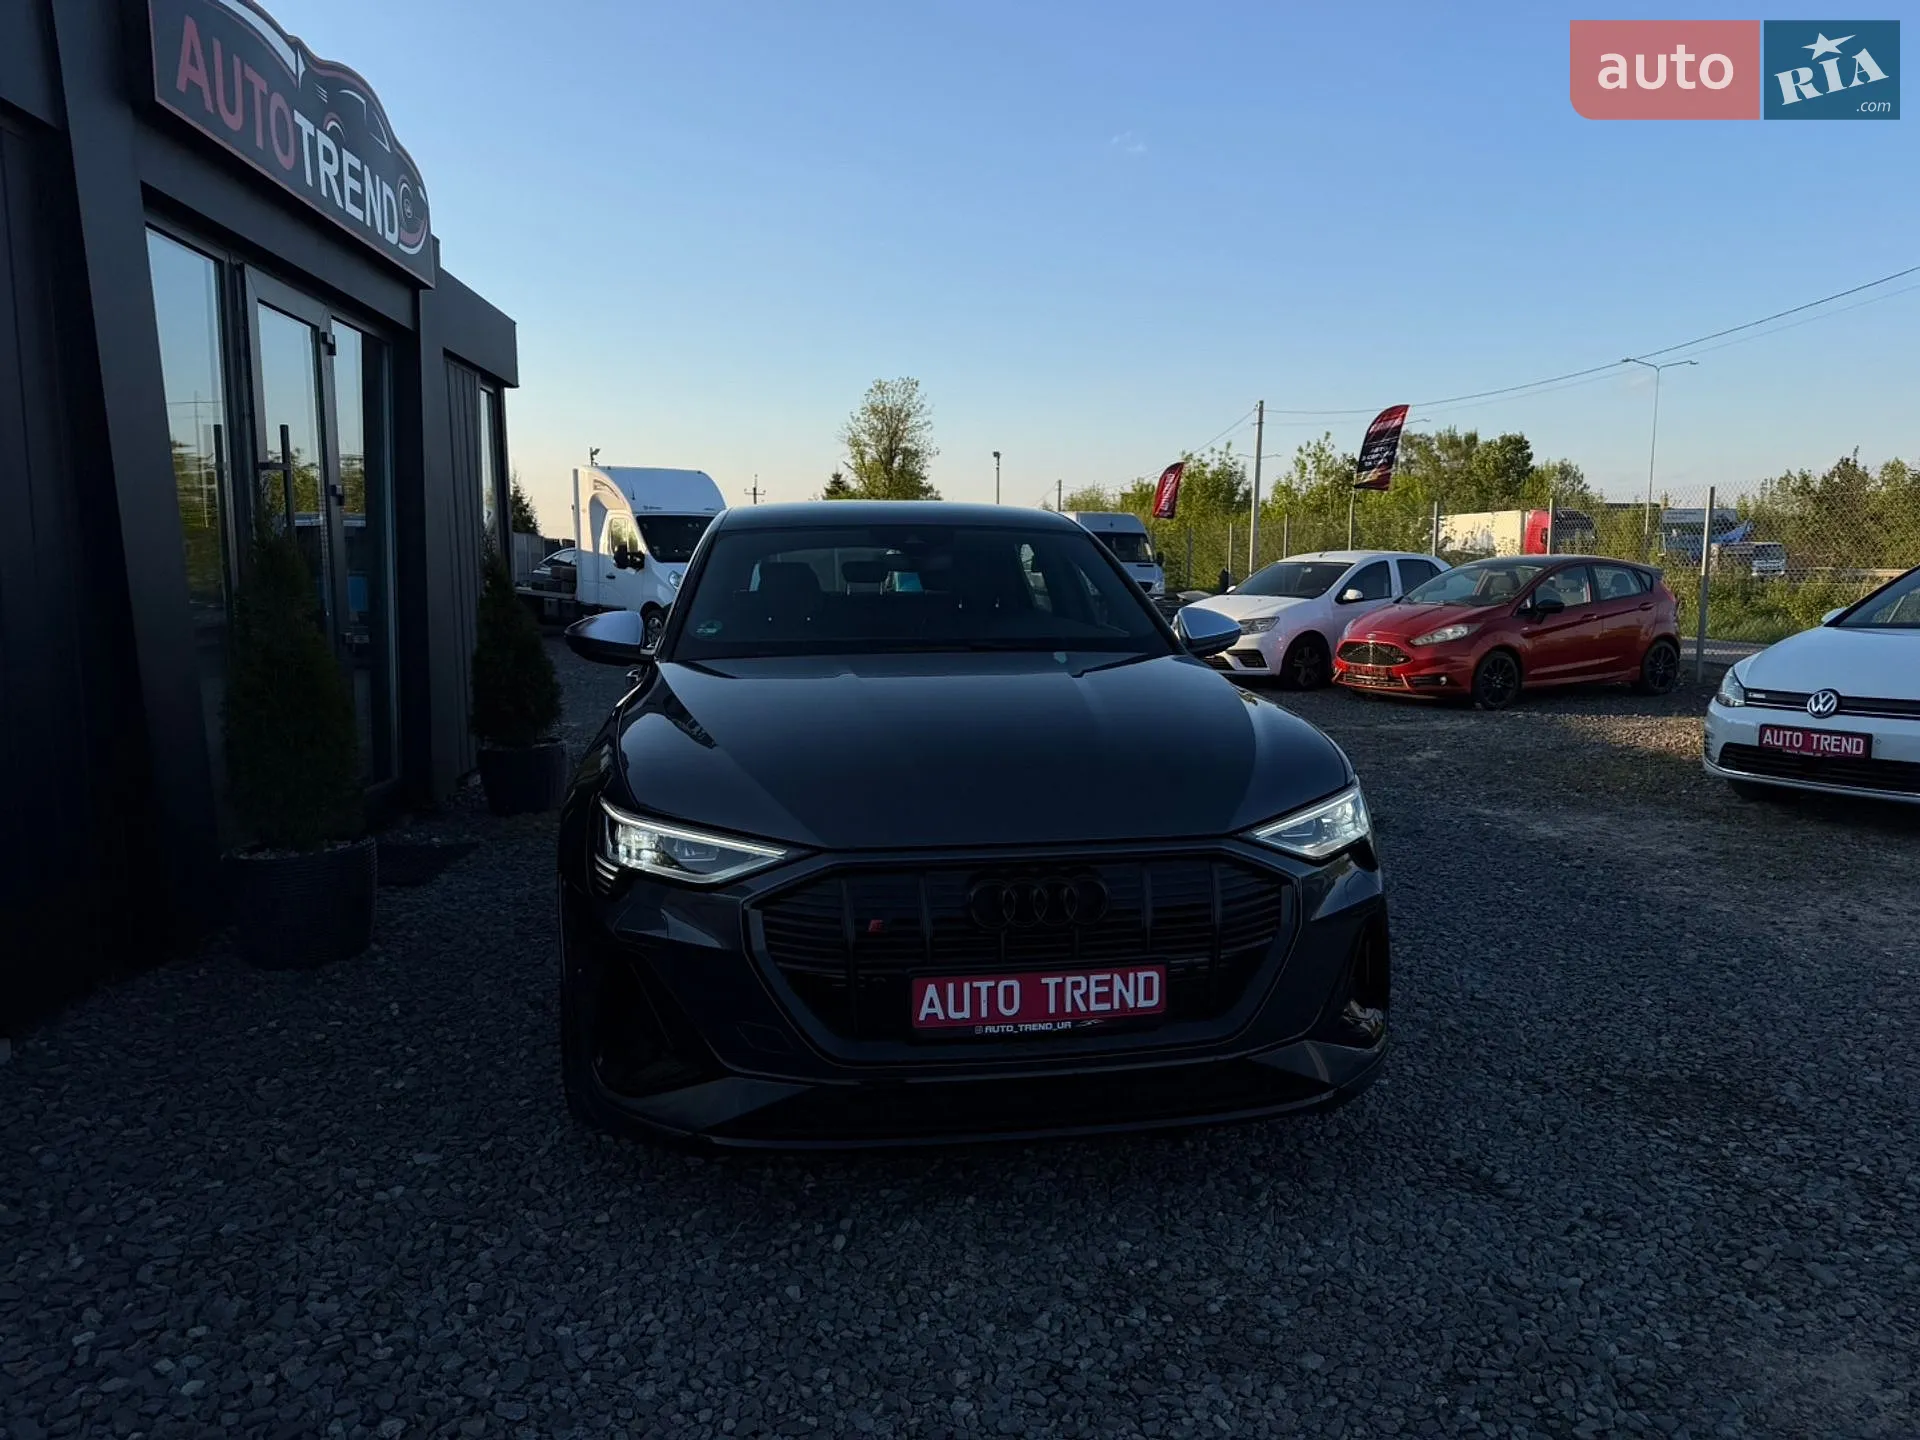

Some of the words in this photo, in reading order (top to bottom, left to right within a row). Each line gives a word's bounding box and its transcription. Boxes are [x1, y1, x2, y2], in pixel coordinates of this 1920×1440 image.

[1762, 729, 1803, 748] AUTO
[1810, 733, 1864, 755] TREND
[918, 979, 1021, 1021] AUTO
[1041, 971, 1160, 1014] TREND
